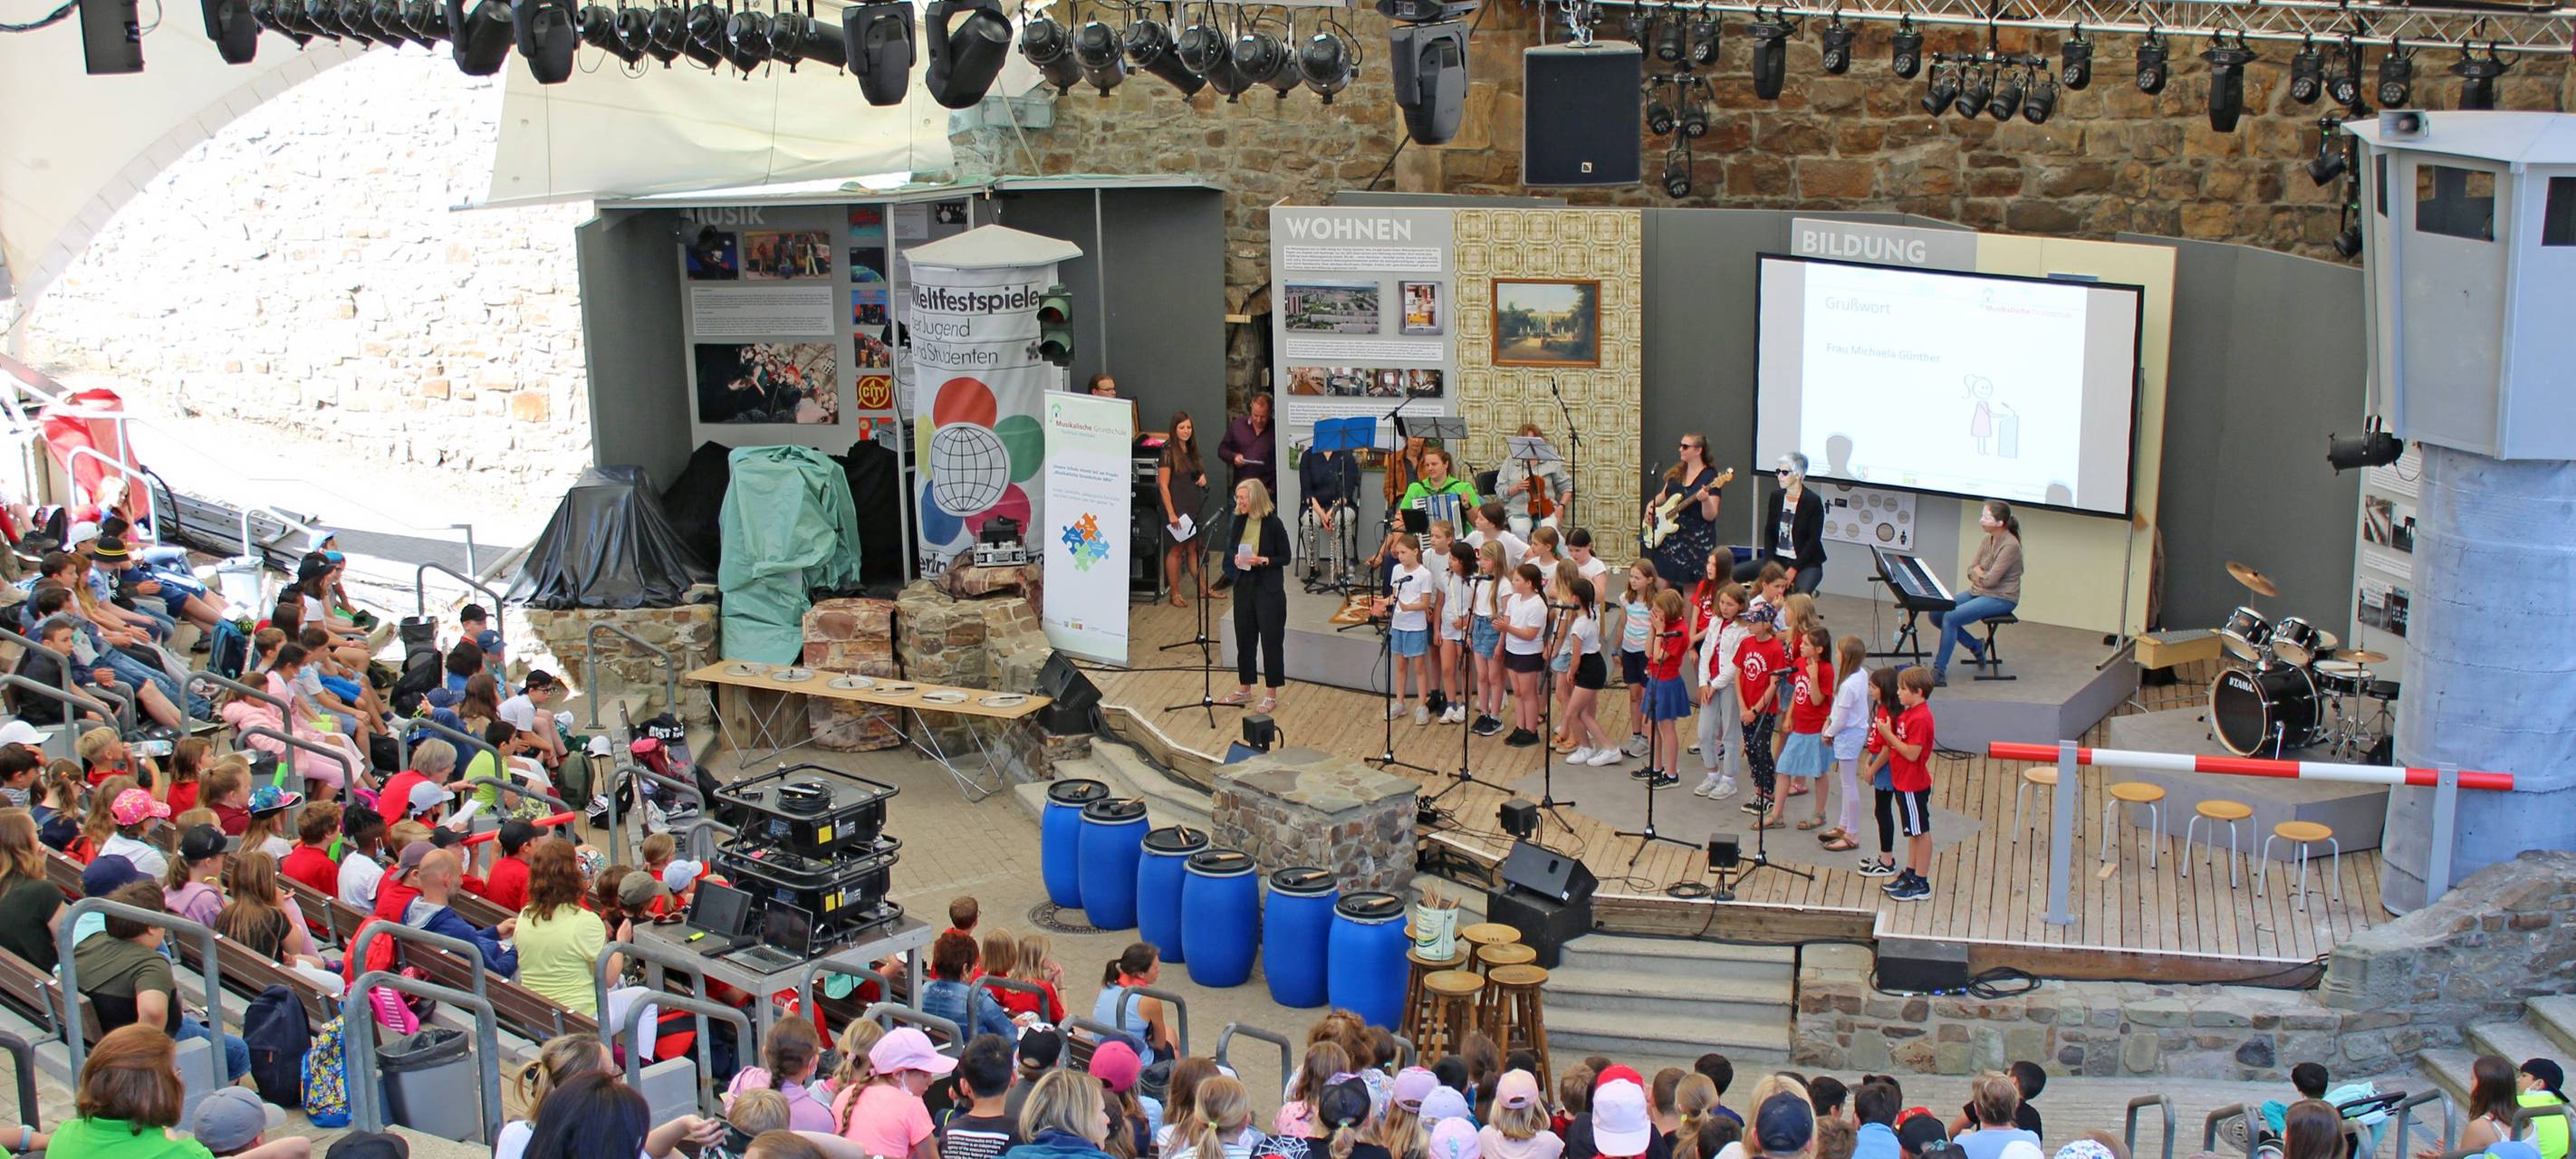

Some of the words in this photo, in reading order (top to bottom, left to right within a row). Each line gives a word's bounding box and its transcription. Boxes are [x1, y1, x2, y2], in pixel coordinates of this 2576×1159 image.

[1284, 217, 1412, 241] WOHNEN
[1802, 231, 1926, 263] BILDUNG
[1825, 296, 1892, 315] Grußwort
[922, 316, 970, 340] Jugend
[927, 342, 998, 366] Studenten
[1826, 342, 1849, 355] Frau
[1850, 345, 1896, 359] Michaela
[1899, 350, 1942, 363] Günther
[862, 385, 885, 398] CITY
[1056, 420, 1092, 431] Musikalische
[919, 552, 947, 574] erlin
